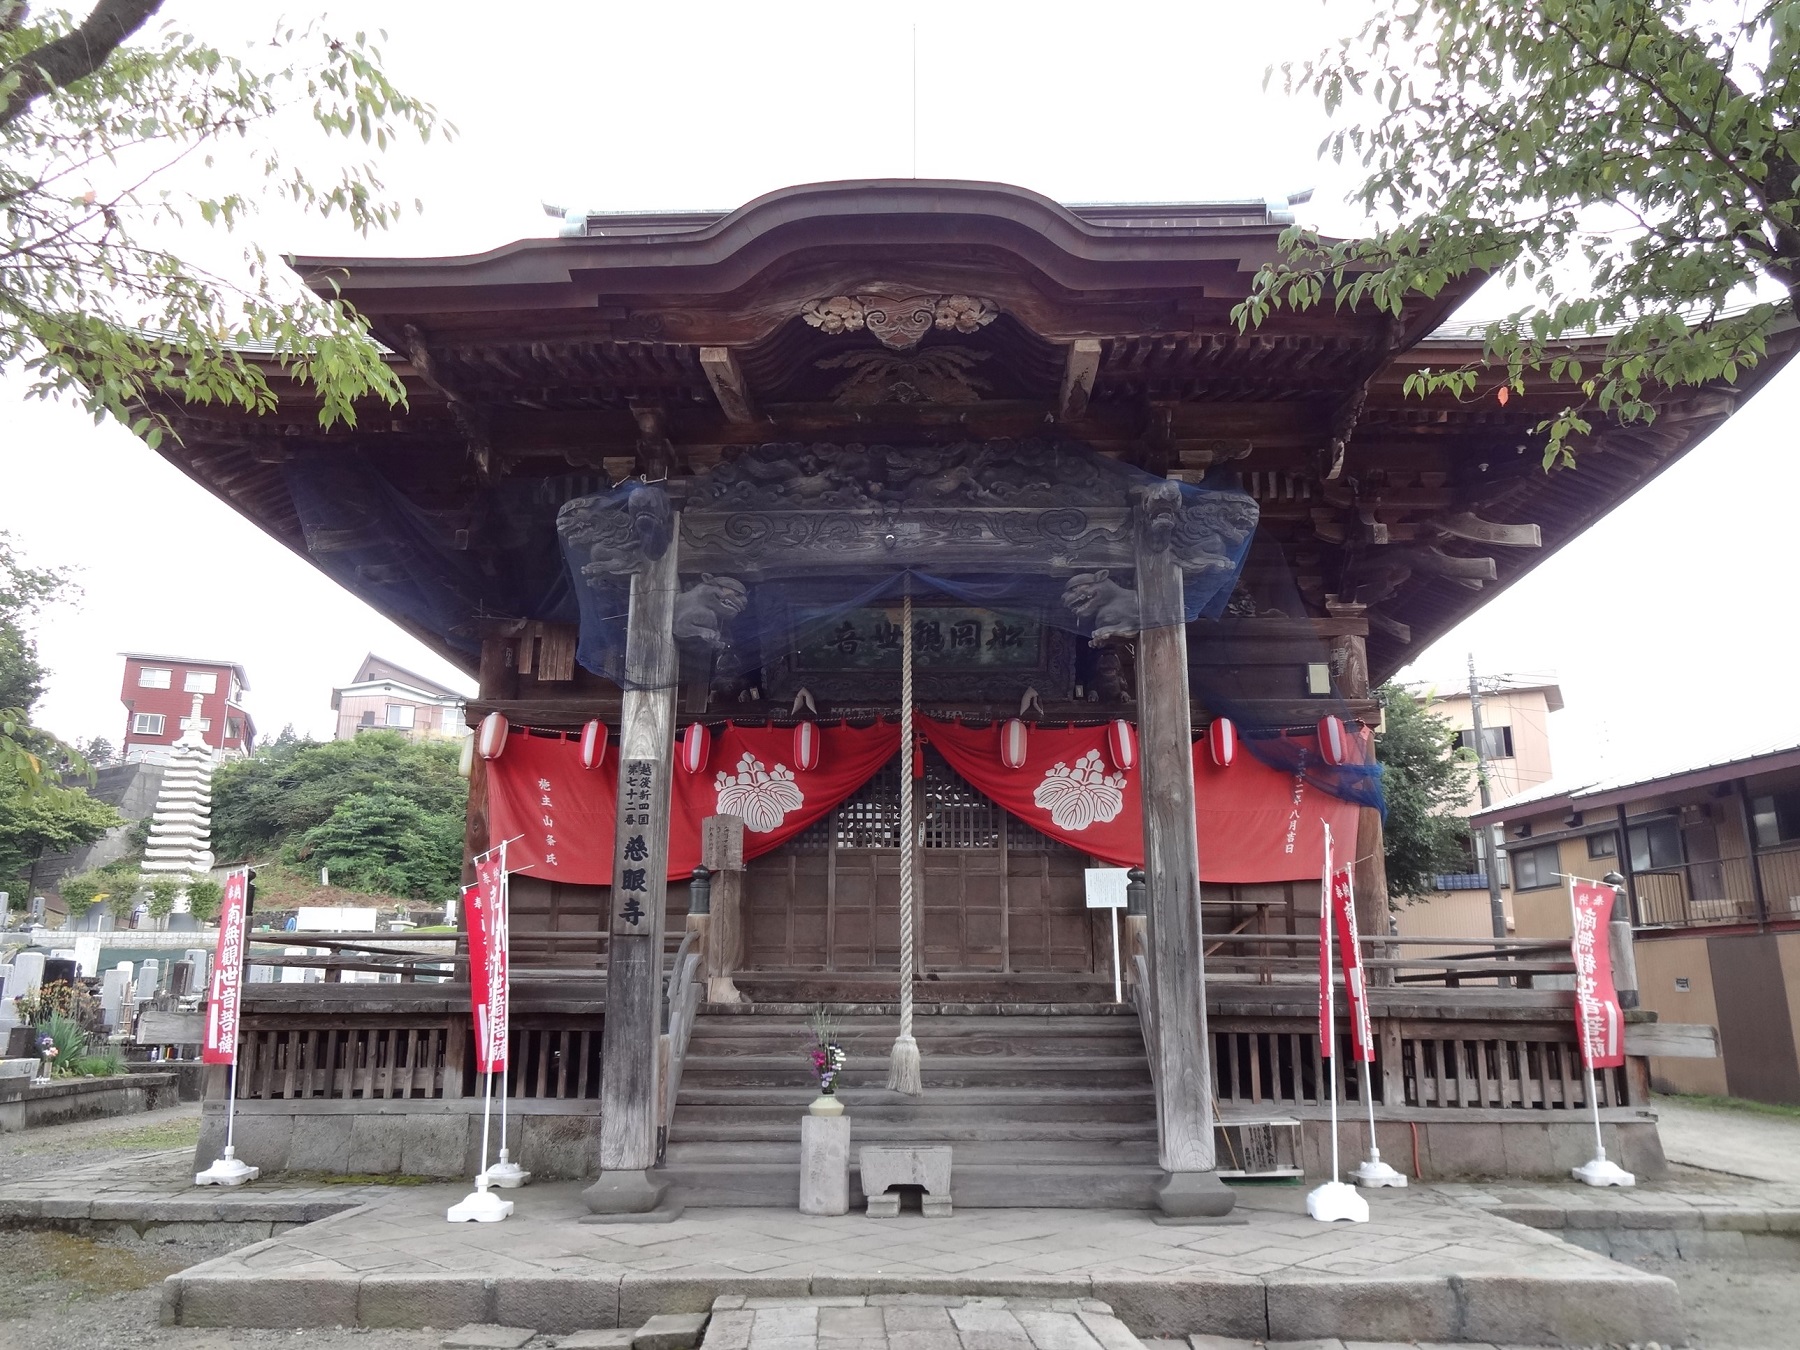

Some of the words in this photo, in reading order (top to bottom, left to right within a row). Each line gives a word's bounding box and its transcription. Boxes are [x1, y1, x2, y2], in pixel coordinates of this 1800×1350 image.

[624, 764, 638, 826] 第七十二番
[618, 834, 649, 927] 慈眼寺
[218, 902, 241, 1054] 南無観世音菩薩
